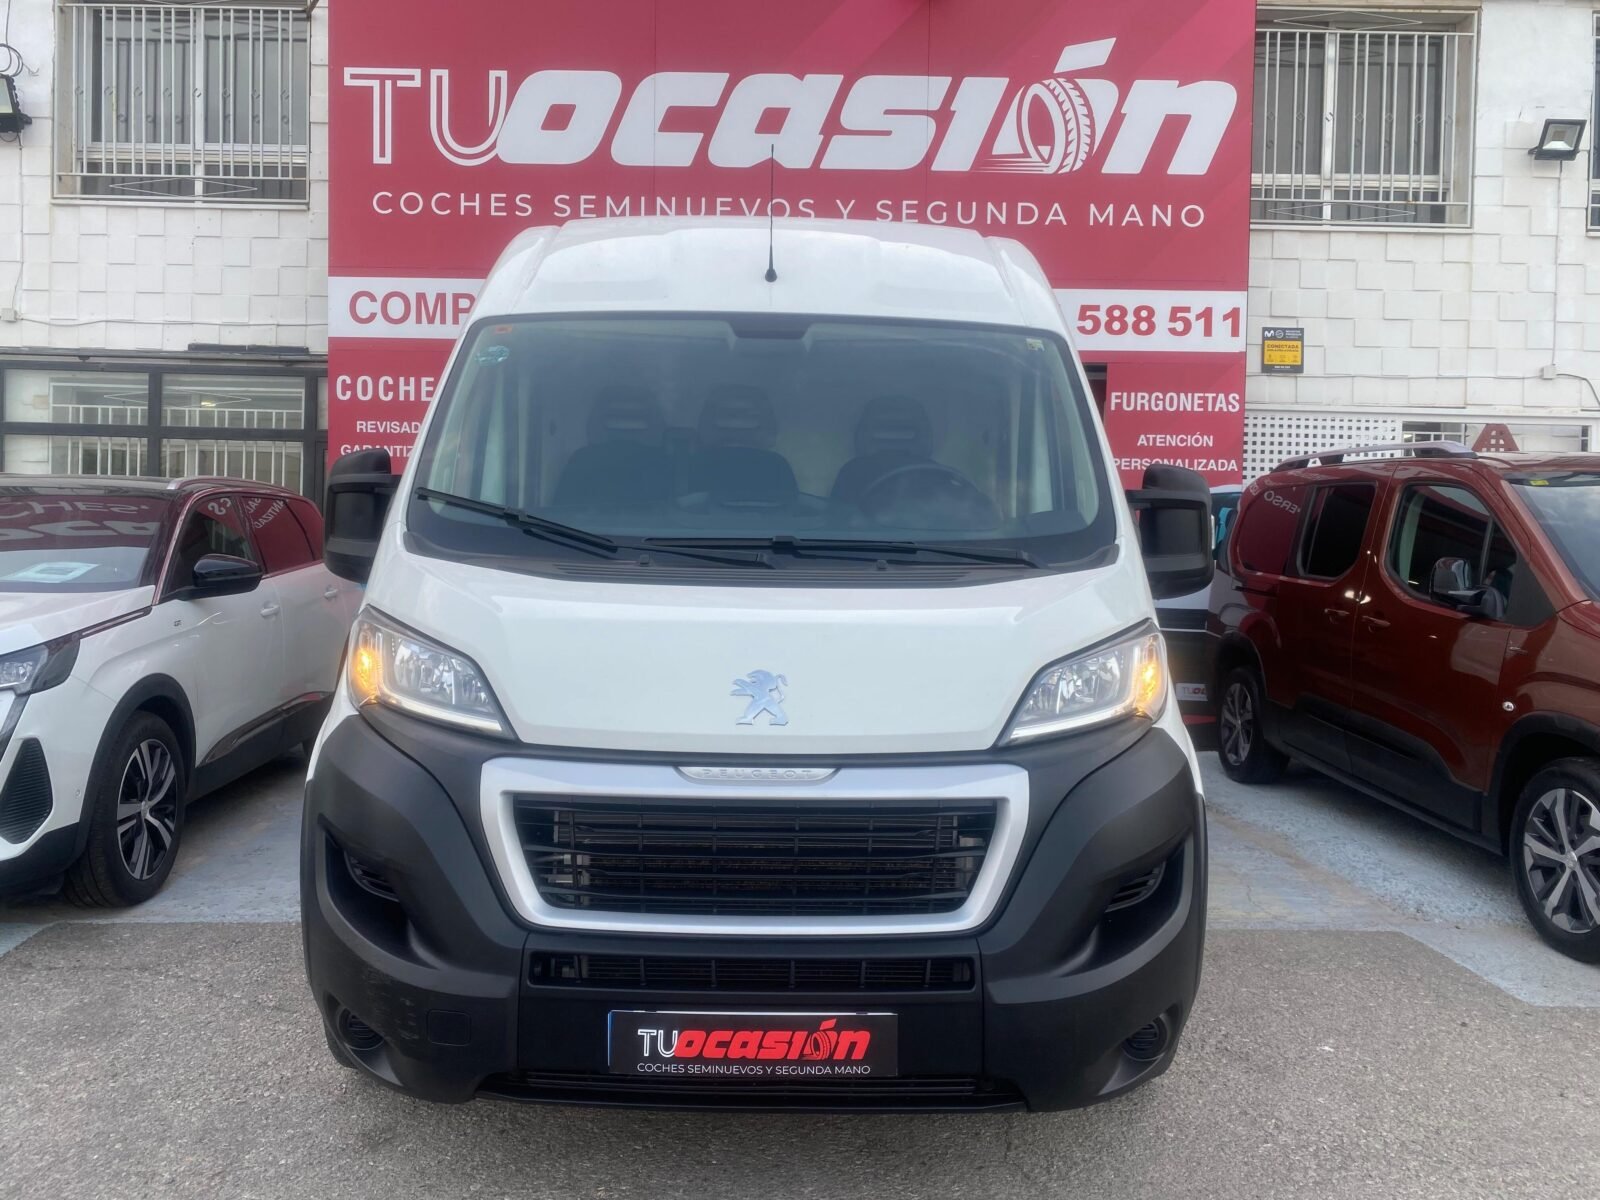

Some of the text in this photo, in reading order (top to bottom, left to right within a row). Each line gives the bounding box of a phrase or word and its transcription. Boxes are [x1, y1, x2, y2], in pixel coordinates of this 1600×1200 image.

[372, 191, 1205, 228] COCHES SEMINUEVOS Y SEGUNDA MANO
[348, 290, 477, 326] COMP
[1076, 304, 1241, 338] 588 511
[1110, 391, 1240, 412] FURGONETAS
[1137, 432, 1214, 447] ATENCIÓN
[701, 768, 812, 780] PEUGEOT
[637, 1062, 871, 1076] COCHES SEMINUEVOS Y SEGUNDA MANO
